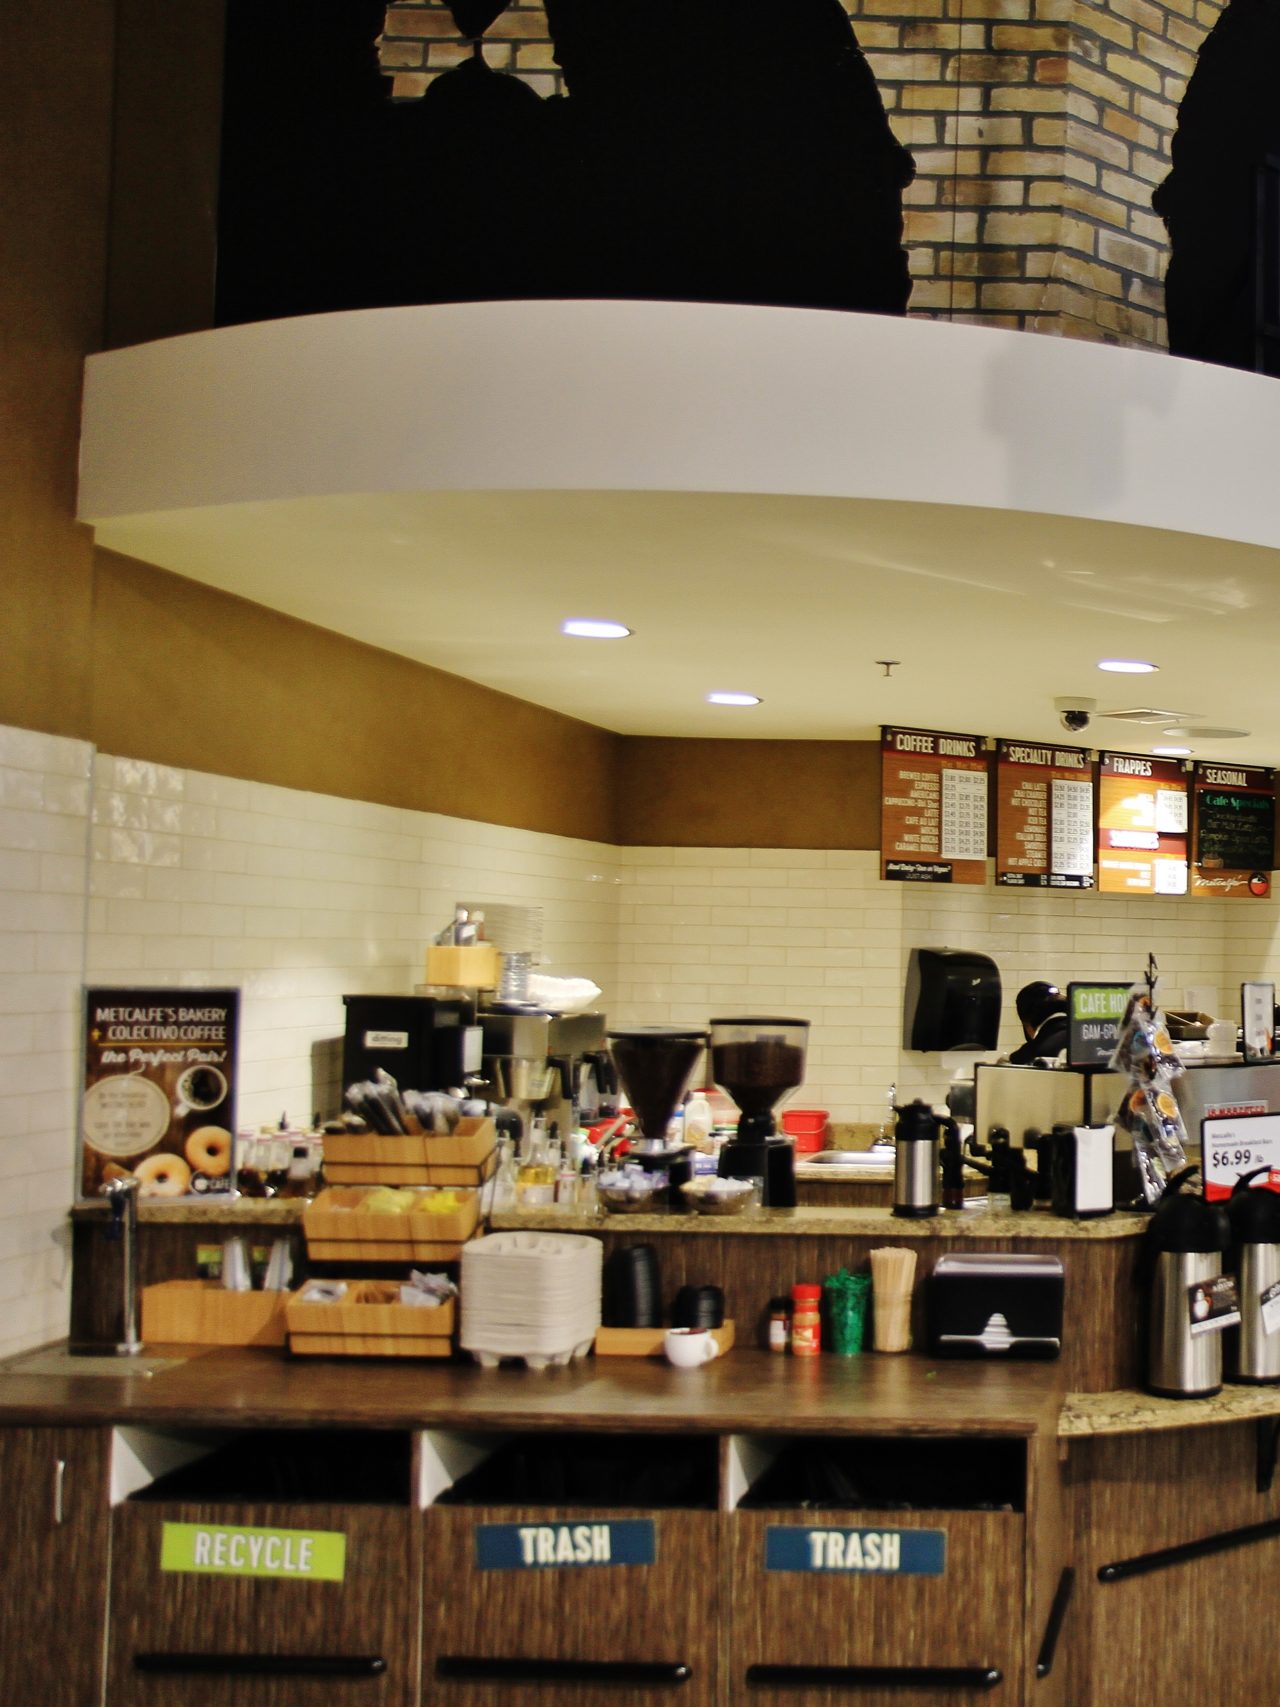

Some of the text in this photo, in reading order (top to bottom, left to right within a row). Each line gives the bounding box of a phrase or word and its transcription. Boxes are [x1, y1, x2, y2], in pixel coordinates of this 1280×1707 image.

[896, 734, 976, 757] COFFEE DRINKS
[1009, 746, 1084, 768] SPECIALTY DRINKS
[1113, 757, 1152, 776] FRAPPES
[1206, 769, 1248, 786] SEASONAL
[1080, 991, 1107, 1013] CAFE
[96, 1007, 227, 1022] METCALFE'S BAKERY
[108, 1025, 178, 1040] COLECTIVO
[180, 1025, 226, 1040] COFFEE
[102, 1048, 227, 1067] the Perfect Pair!
[1212, 1149, 1251, 1168] $6.99
[193, 1530, 314, 1572] RECYCLE
[518, 1525, 611, 1565] TRASH
[808, 1531, 901, 1571] TRASH
